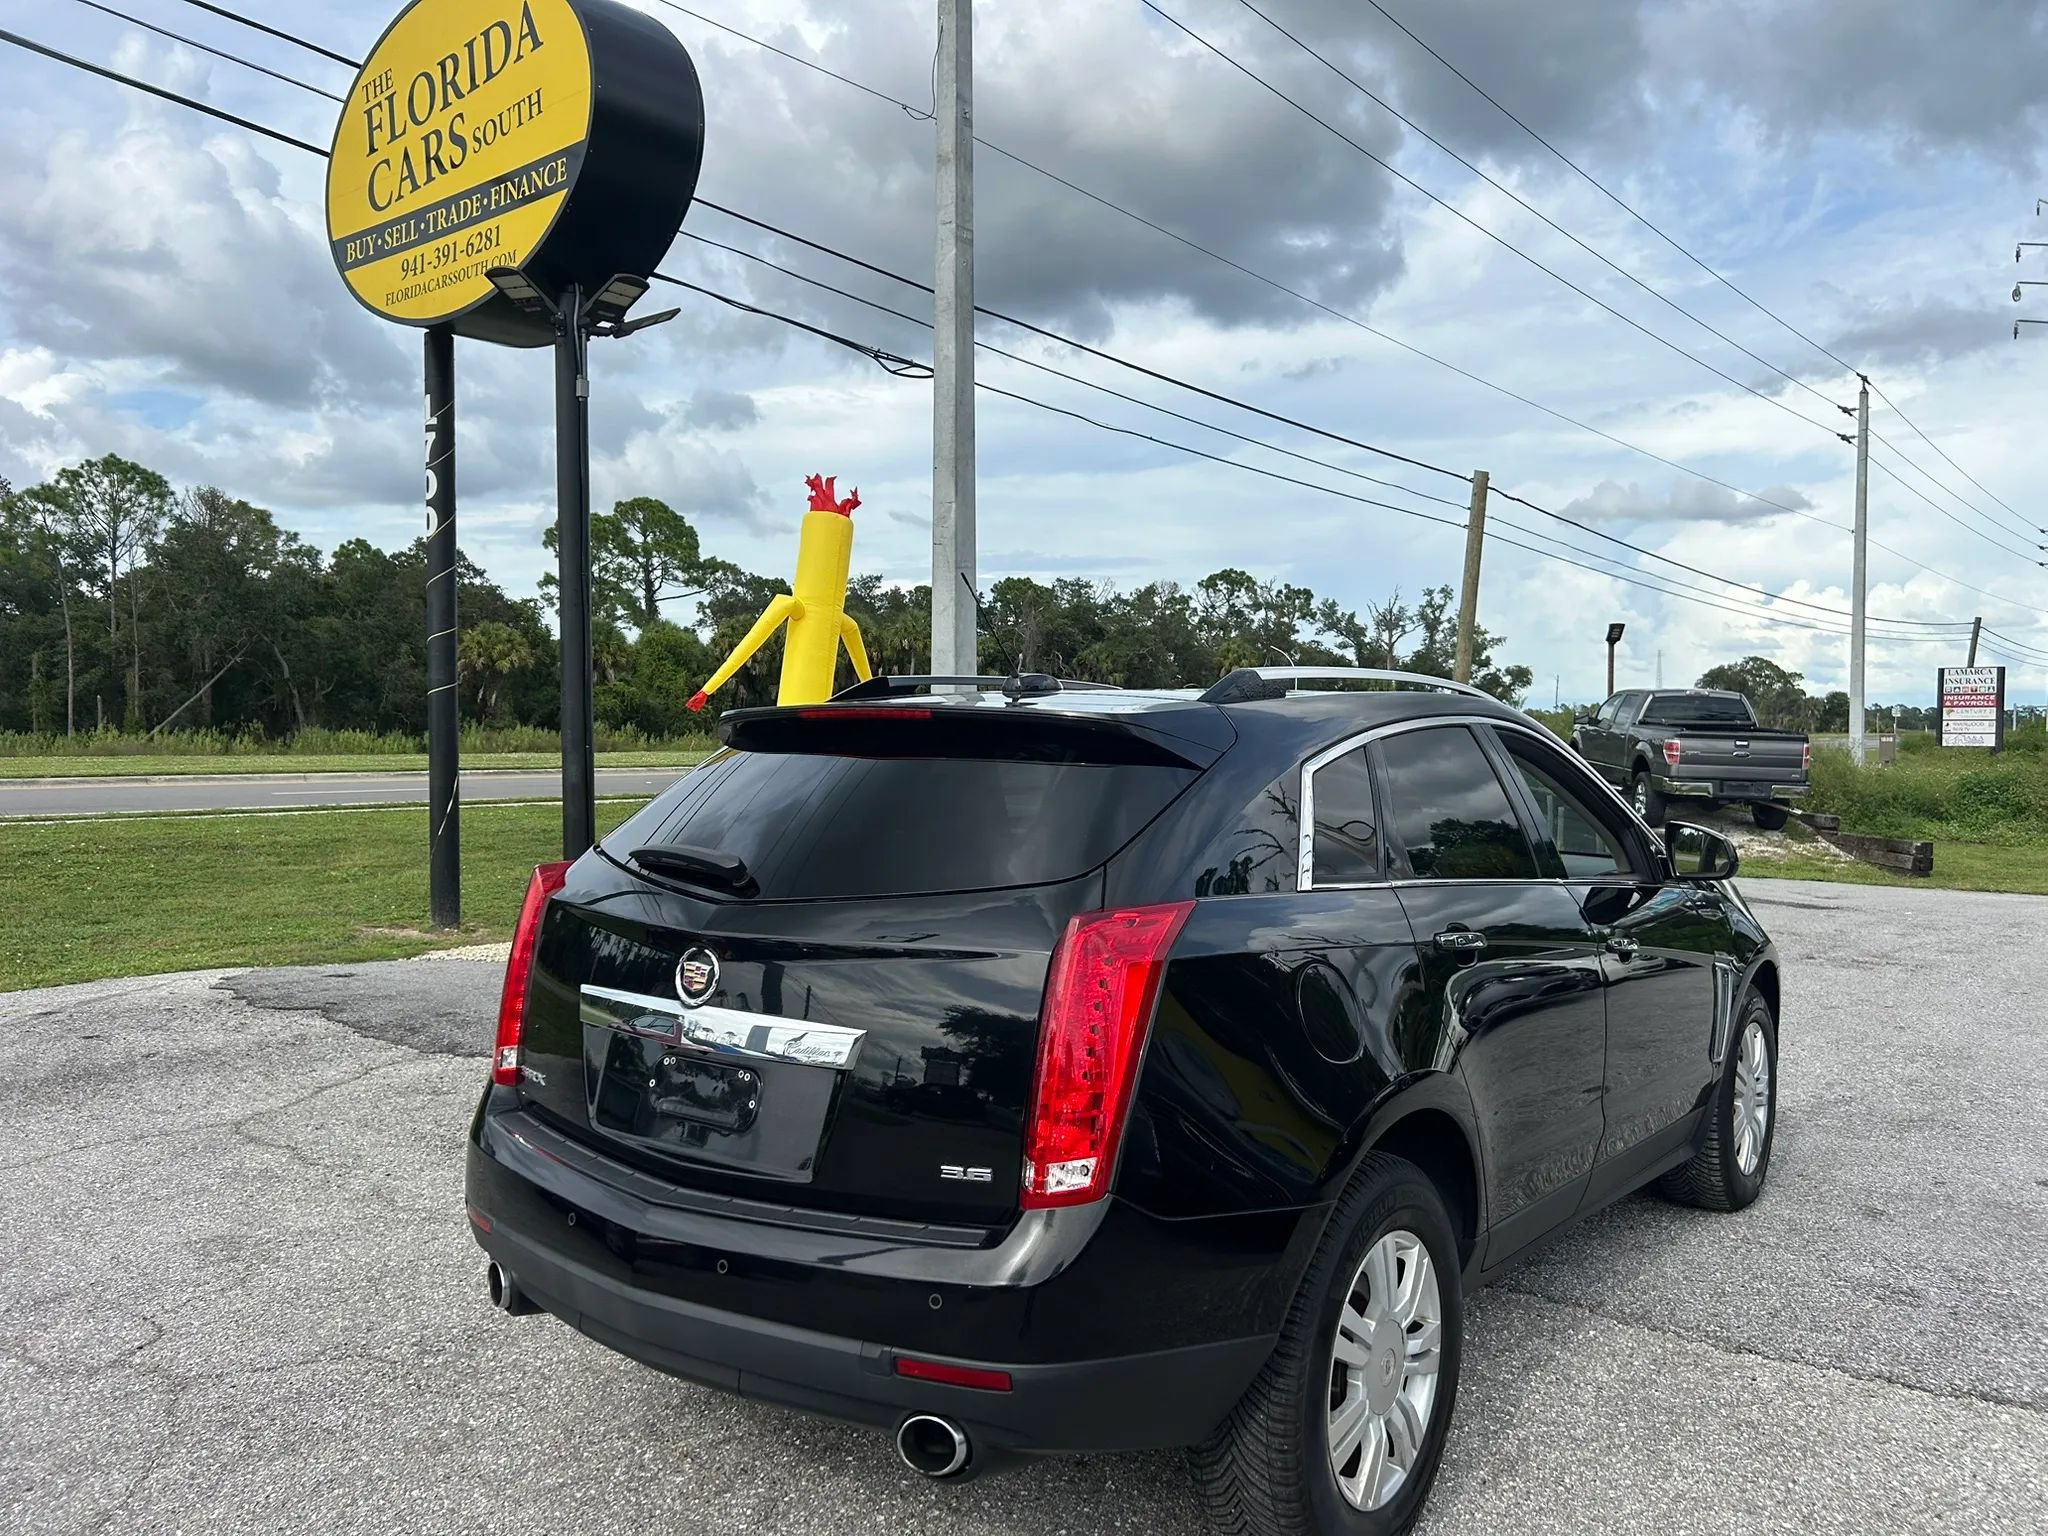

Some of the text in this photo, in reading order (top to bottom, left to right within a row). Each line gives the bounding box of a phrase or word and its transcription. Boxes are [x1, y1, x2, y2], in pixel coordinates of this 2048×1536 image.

[361, 68, 394, 104] THE
[363, 0, 544, 158] FLORIDA
[367, 88, 543, 212] CARS SOUTH
[346, 157, 568, 263] BUY SELL TRADE FINANCE
[400, 224, 501, 281] 941-391-6281
[385, 249, 518, 307] FLORIDACARSSOUTHCOM
[1945, 677, 1996, 685] INSURANCE
[1948, 668, 1993, 676] LAMARCA
[785, 1038, 832, 1058] Cadillac
[940, 1165, 993, 1182] 3.6
